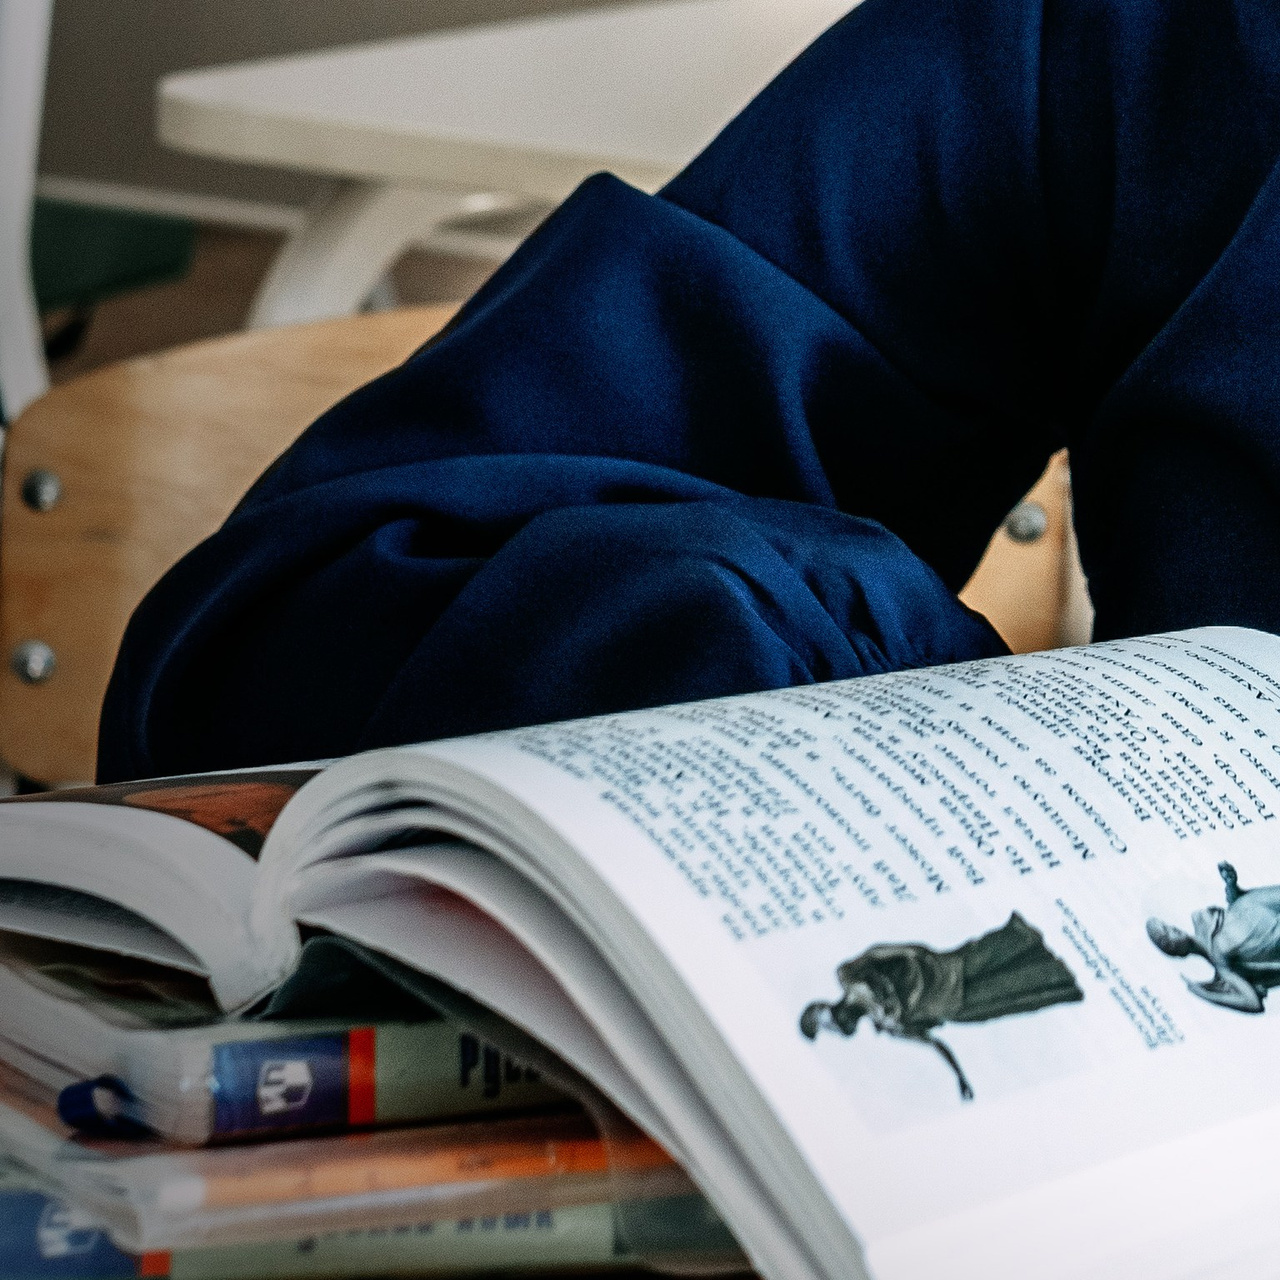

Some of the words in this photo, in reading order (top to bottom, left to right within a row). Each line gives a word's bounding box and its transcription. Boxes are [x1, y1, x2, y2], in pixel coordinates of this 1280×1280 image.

[1036, 670, 1092, 698] лишь
[1102, 673, 1156, 706] лишь
[1185, 650, 1273, 702] Ахиллес,
[1097, 704, 1147, 742] Один
[1166, 691, 1214, 724] нему
[1214, 696, 1249, 722] низ
[981, 716, 1029, 751] этим
[1087, 725, 1111, 743] из
[1115, 732, 1151, 762] они
[1147, 727, 1170, 744] не
[1161, 712, 1203, 746] едва
[934, 744, 996, 798] тотчас
[1035, 758, 1057, 775] за
[1073, 745, 1151, 821] Вовремя
[1176, 752, 1213, 786] ним
[907, 751, 1000, 838] Патроклу
[1120, 752, 1201, 836] троянцев
[1123, 768, 1187, 839] пление.
[1157, 770, 1216, 830] «стали
[1160, 750, 1234, 829] смерти».
[1214, 754, 1275, 820] Гектор,
[1013, 775, 1094, 860] Мощную
[1062, 783, 1127, 854] Следом
[1219, 793, 1253, 826] ред
[1003, 806, 1061, 868] Начал
[885, 824, 950, 893] Может
[1005, 845, 1032, 875] Но
